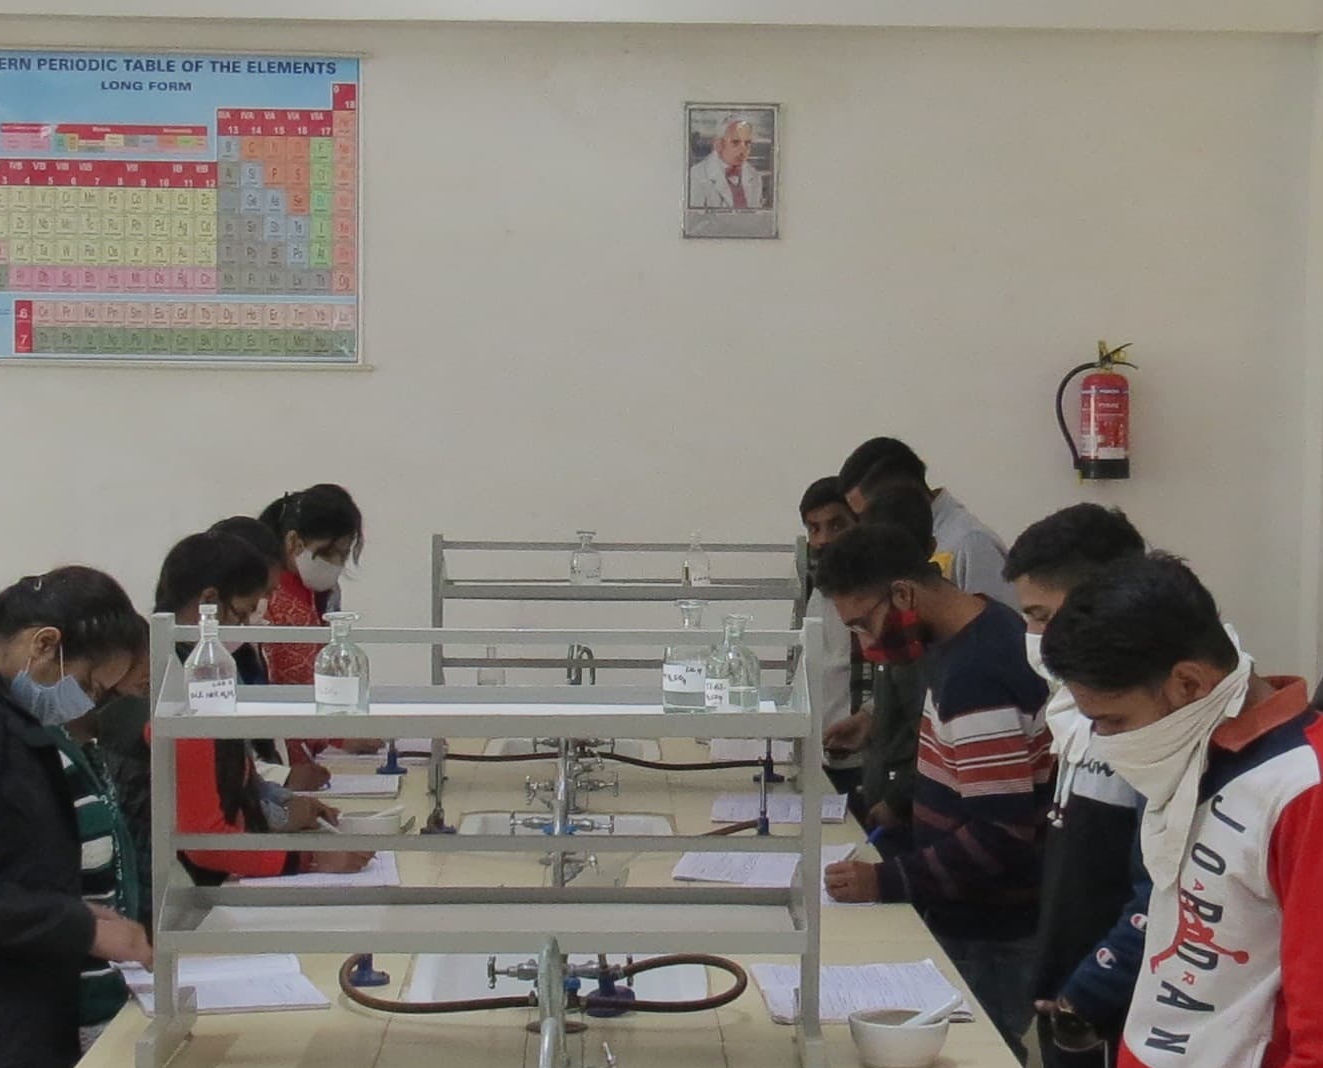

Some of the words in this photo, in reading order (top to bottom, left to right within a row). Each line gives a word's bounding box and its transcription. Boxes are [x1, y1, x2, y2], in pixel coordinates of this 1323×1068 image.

[37, 57, 117, 72] PERIODIC
[123, 59, 176, 73] TABLE
[181, 60, 204, 73] OF
[211, 60, 241, 74] THE
[247, 61, 337, 75] ELEMENTS
[101, 80, 143, 91] LONG
[149, 81, 192, 92] FORM
[228, 126, 238, 135] 13
[251, 126, 262, 135] 14
[274, 127, 285, 135] 15
[321, 127, 331, 136] 17
[1, 175, 8, 184] 3
[24, 175, 30, 184] 4
[47, 176, 54, 185] 5
[94, 177, 100, 186] 7
[159, 178, 169, 187] 10
[184, 178, 193, 188] 11
[206, 179, 216, 188] 12
[19, 307, 28, 319] 6
[20, 334, 28, 345] 7
[1144, 795, 1246, 1055] JORDAN
